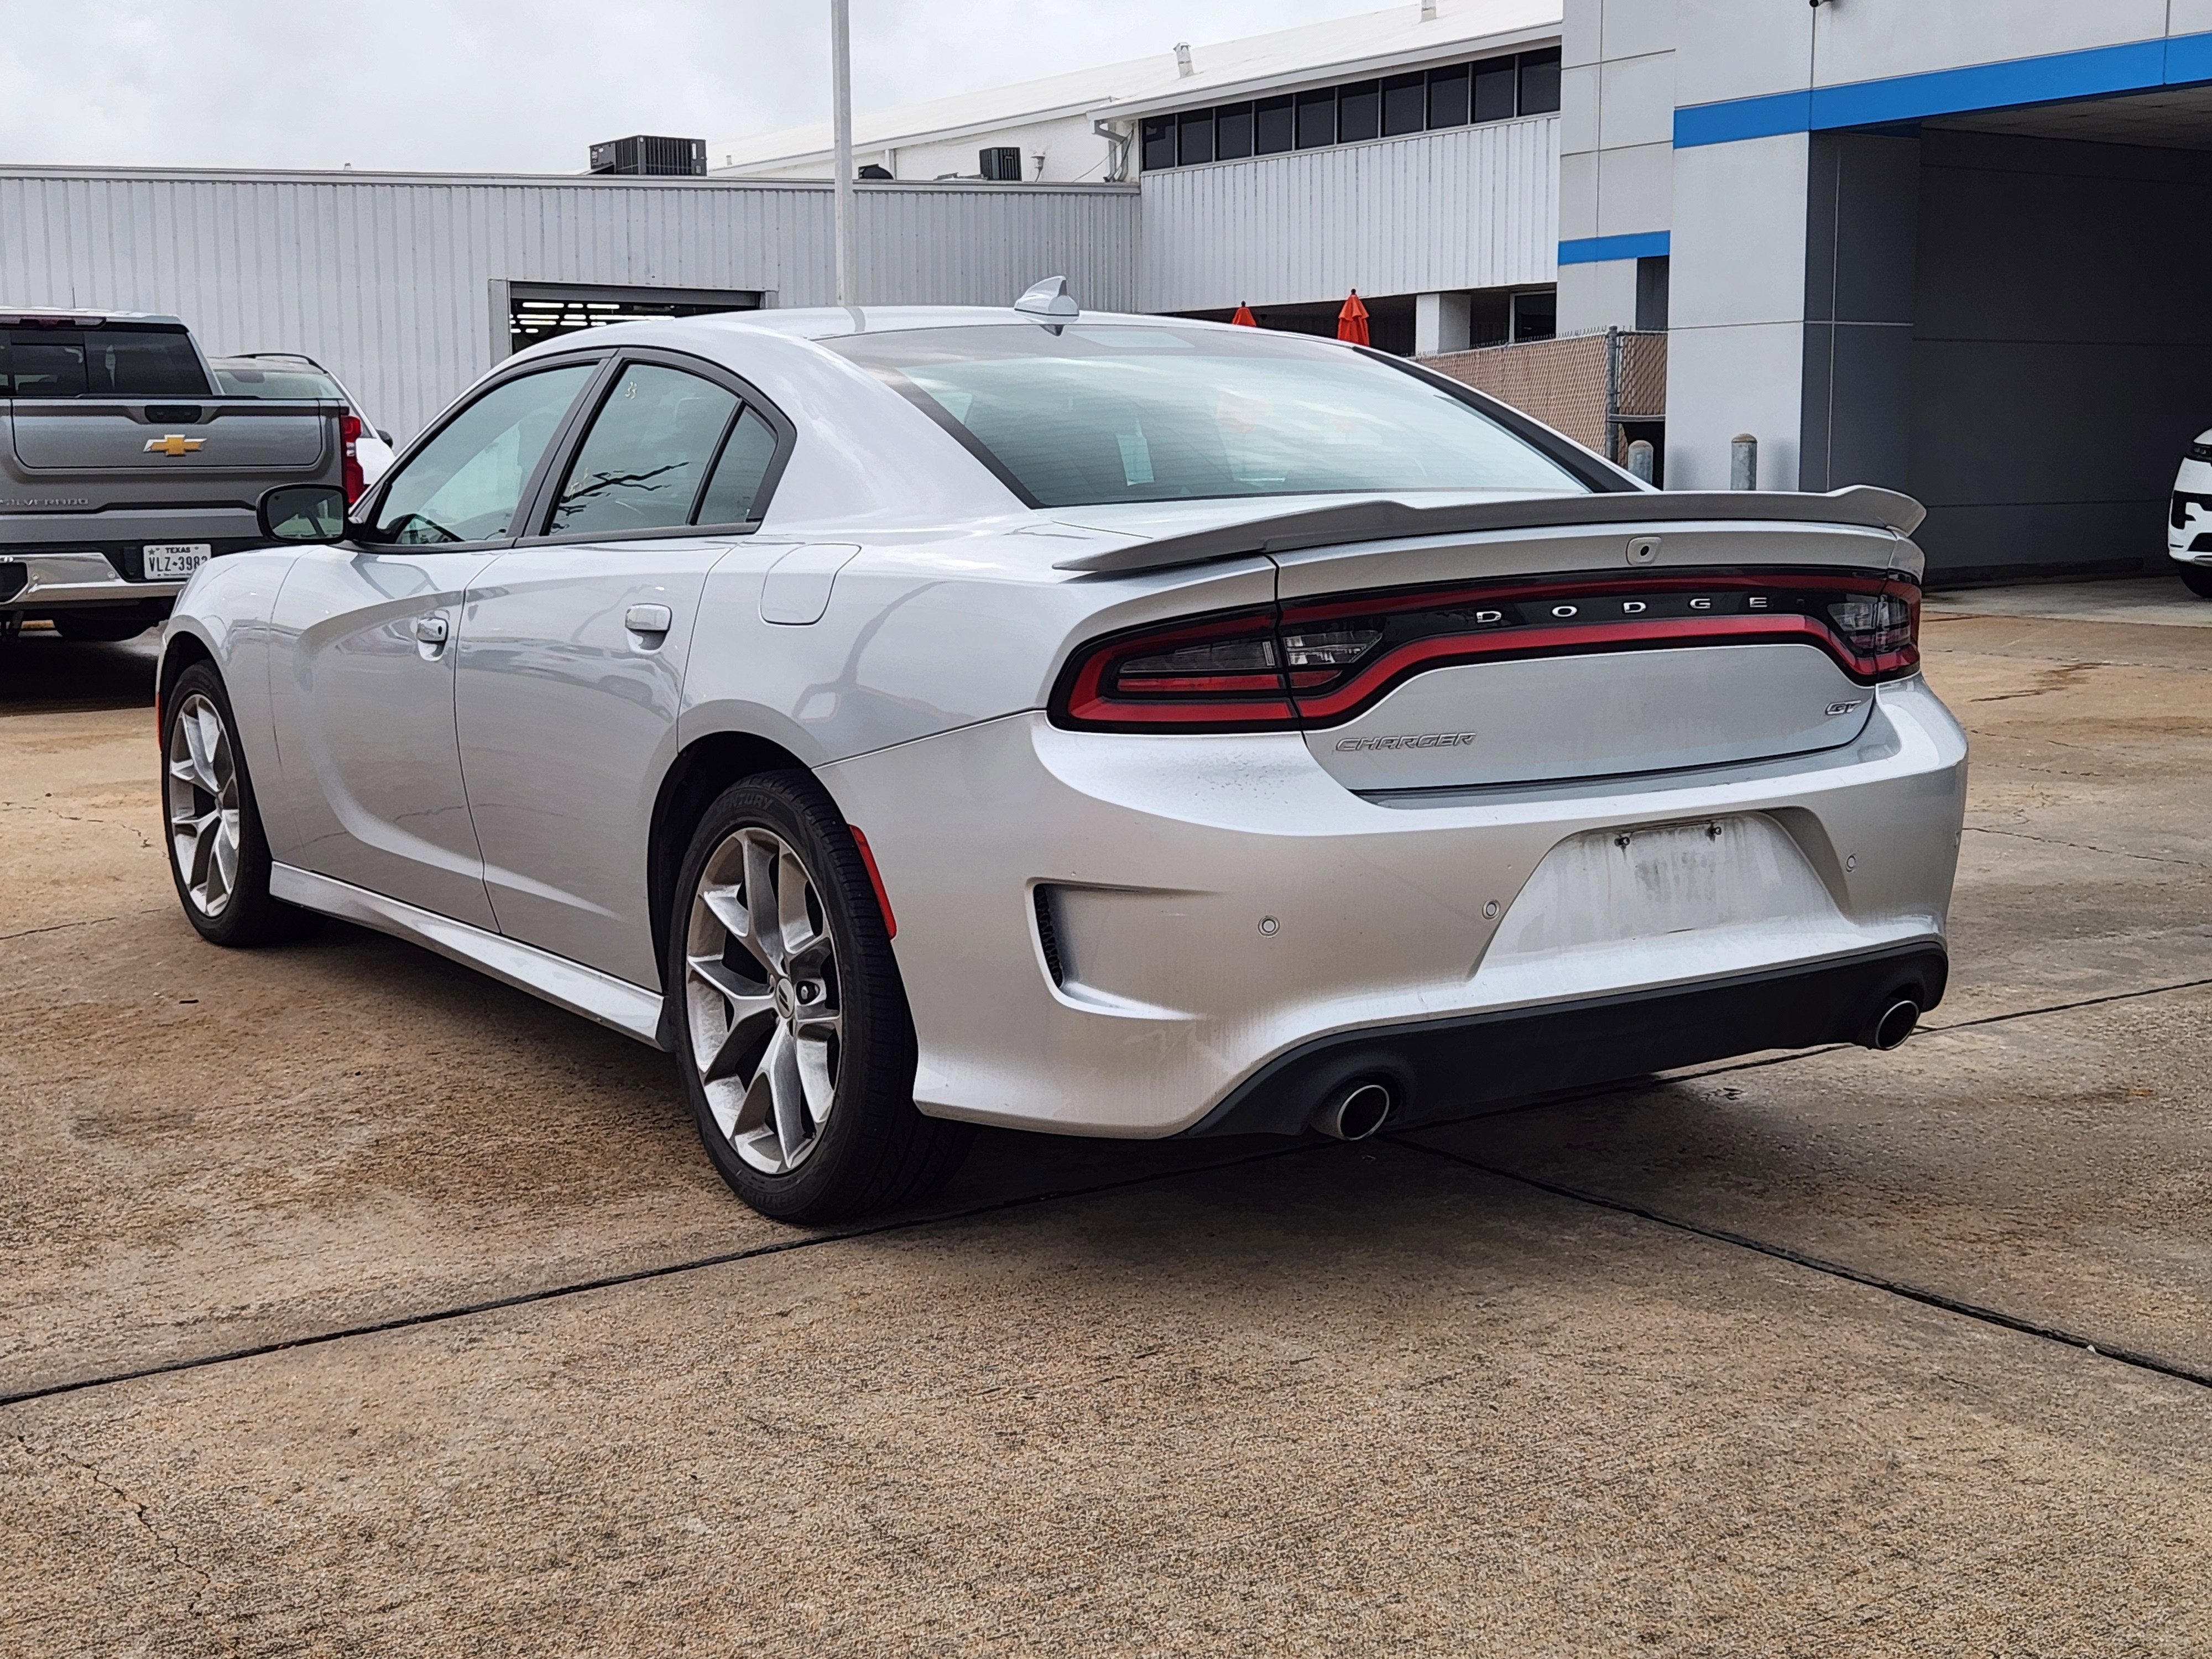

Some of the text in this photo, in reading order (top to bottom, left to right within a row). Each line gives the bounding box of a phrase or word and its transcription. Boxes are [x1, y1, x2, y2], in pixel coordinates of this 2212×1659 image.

[1475, 596, 1768, 623] DODGE
[1825, 700, 1862, 716] GT
[1335, 732, 1477, 752] CHARGER
